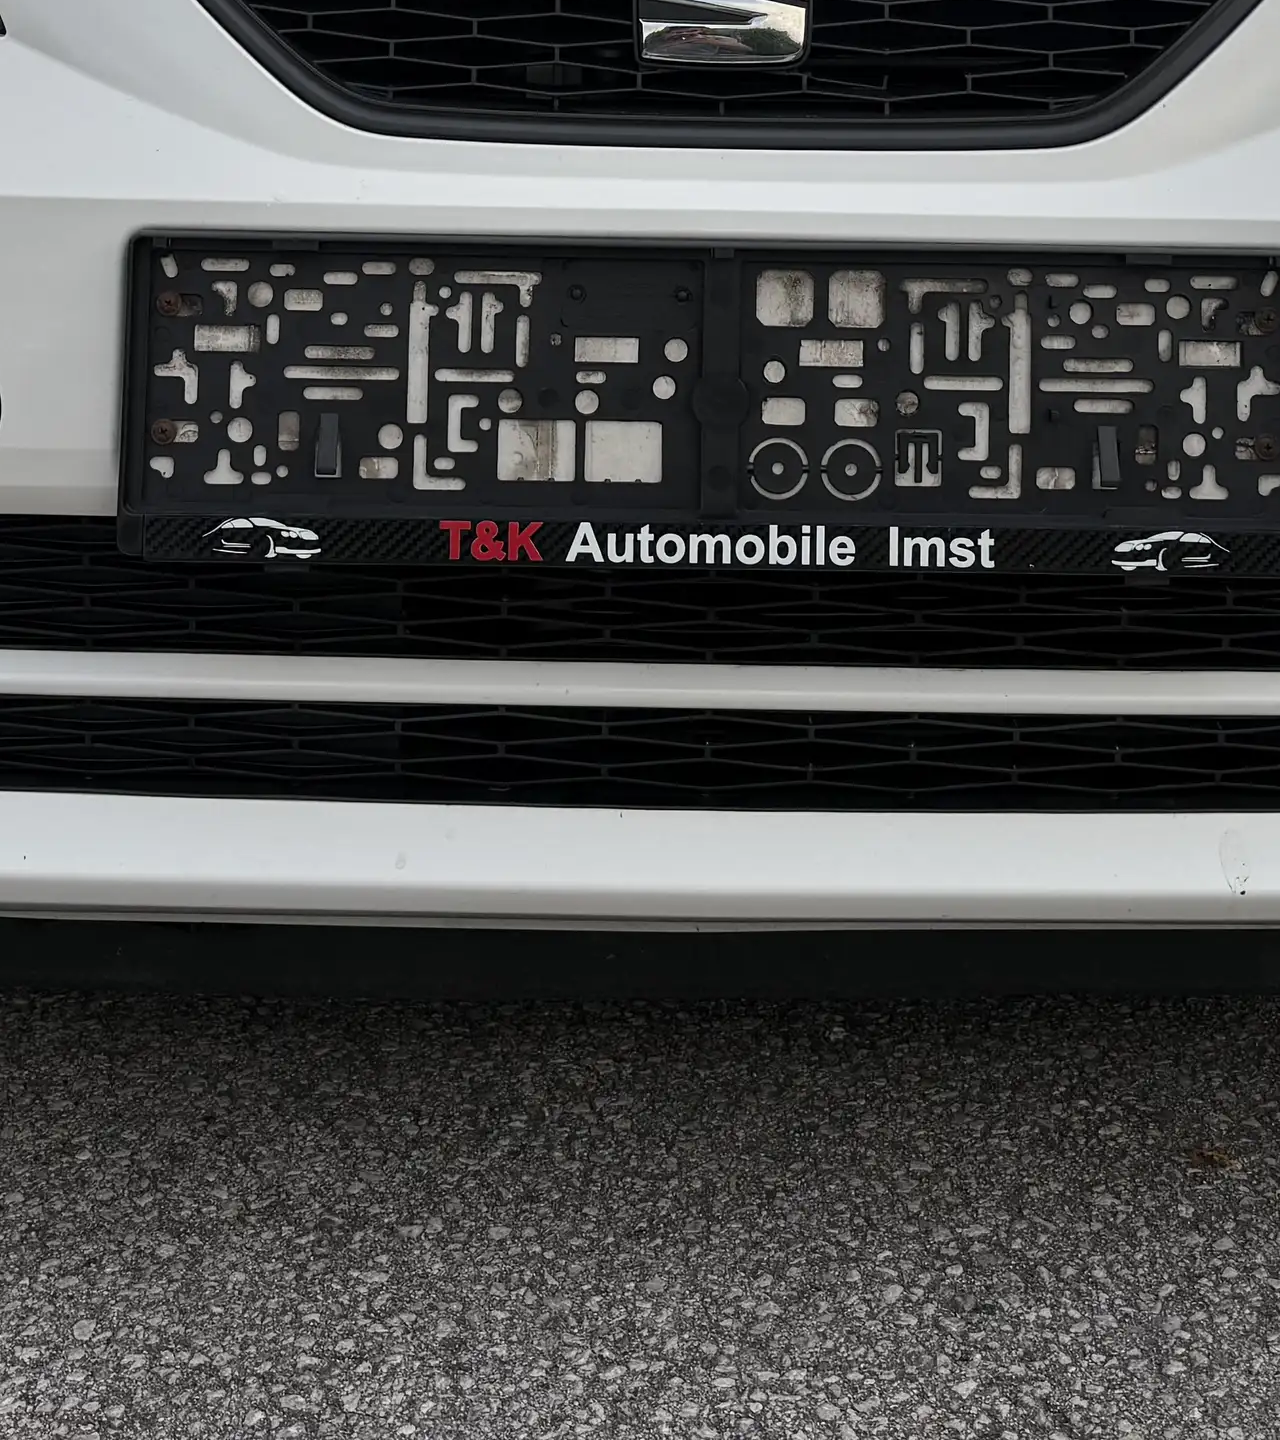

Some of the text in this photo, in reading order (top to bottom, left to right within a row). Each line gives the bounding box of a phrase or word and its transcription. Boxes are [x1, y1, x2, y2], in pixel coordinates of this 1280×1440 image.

[439, 520, 996, 569] T&K Automobile Imst
